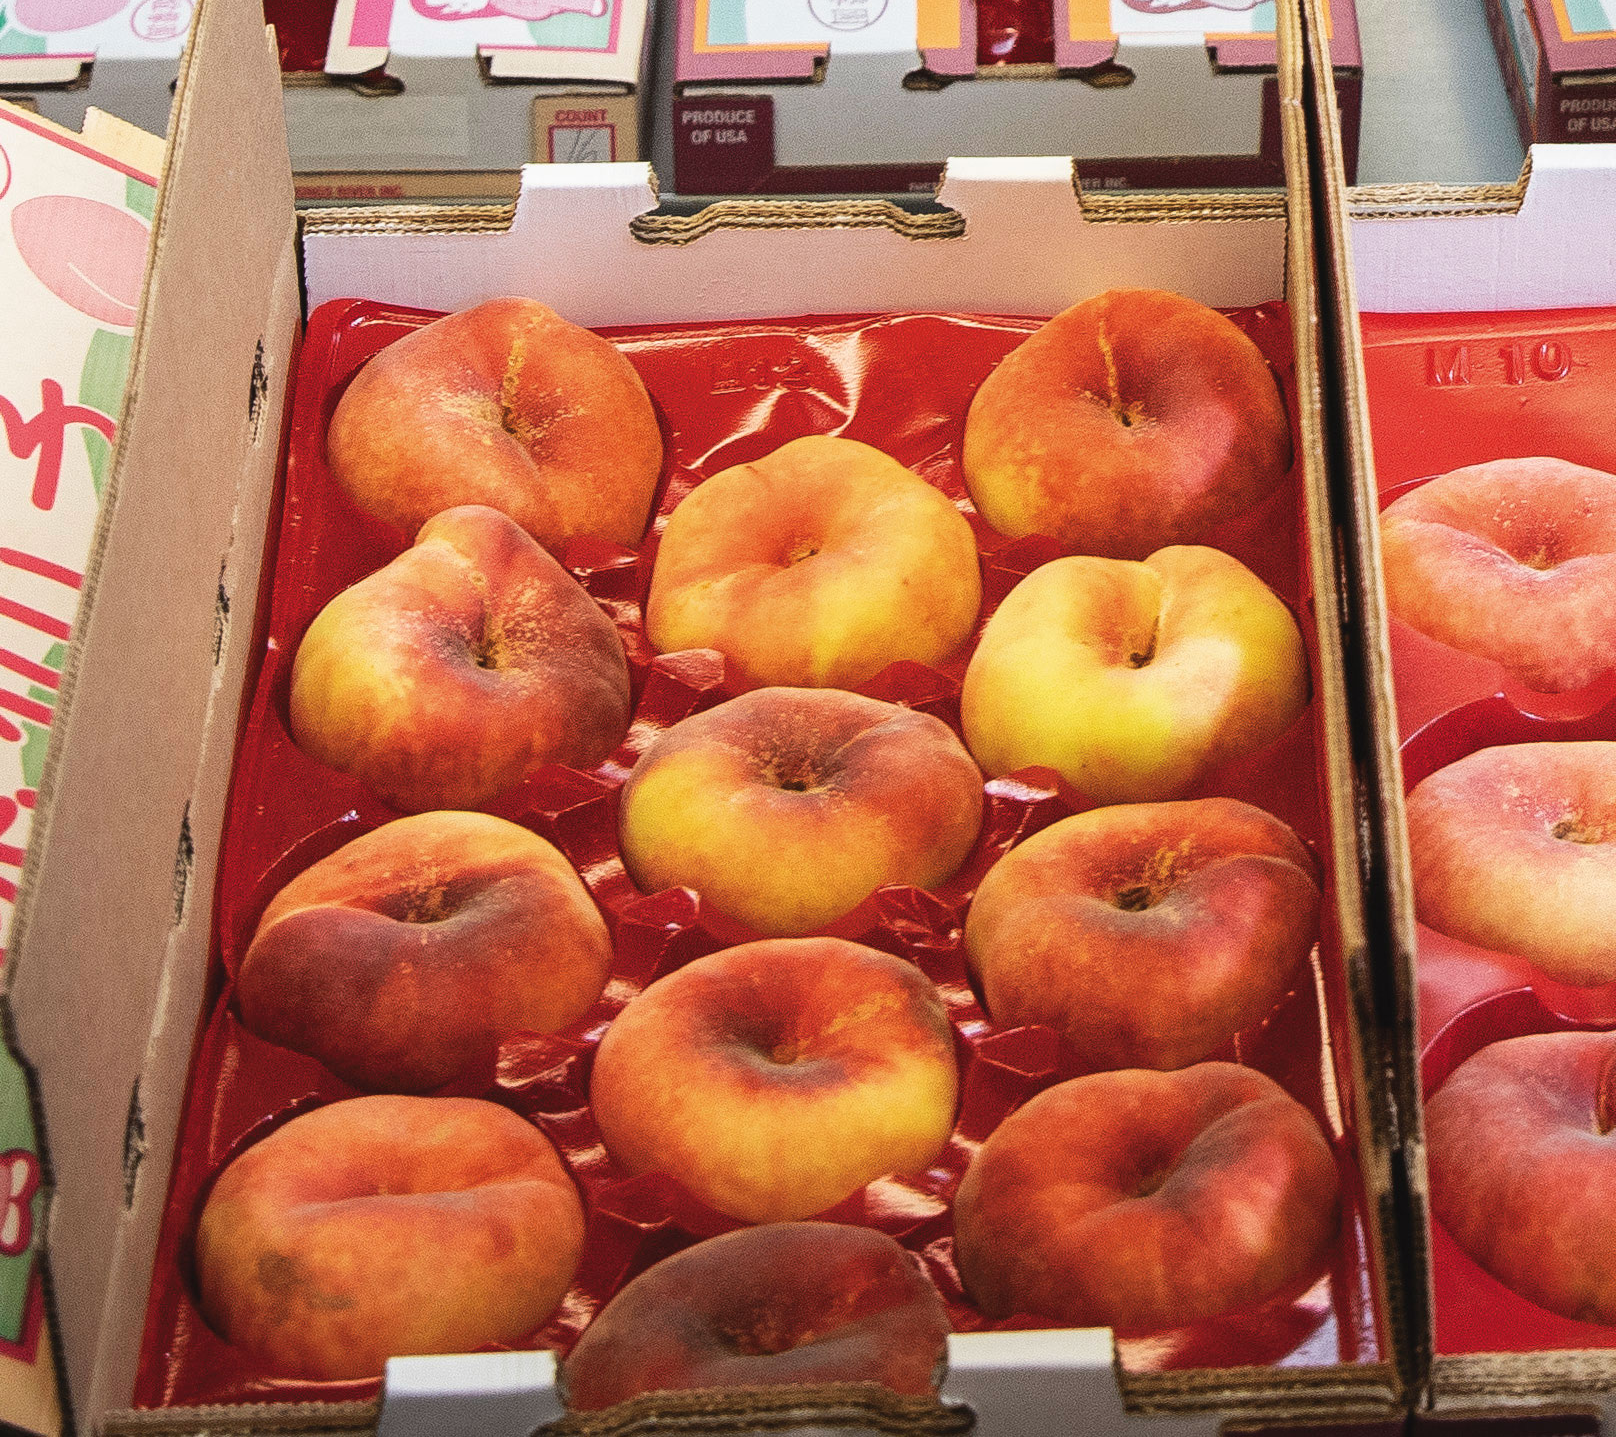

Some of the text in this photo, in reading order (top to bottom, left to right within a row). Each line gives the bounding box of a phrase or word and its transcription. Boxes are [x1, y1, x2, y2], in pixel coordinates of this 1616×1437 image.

[681, 108, 755, 126] PRODUCE
[1567, 118, 1586, 133] OF
[691, 129, 749, 146] OF USA
